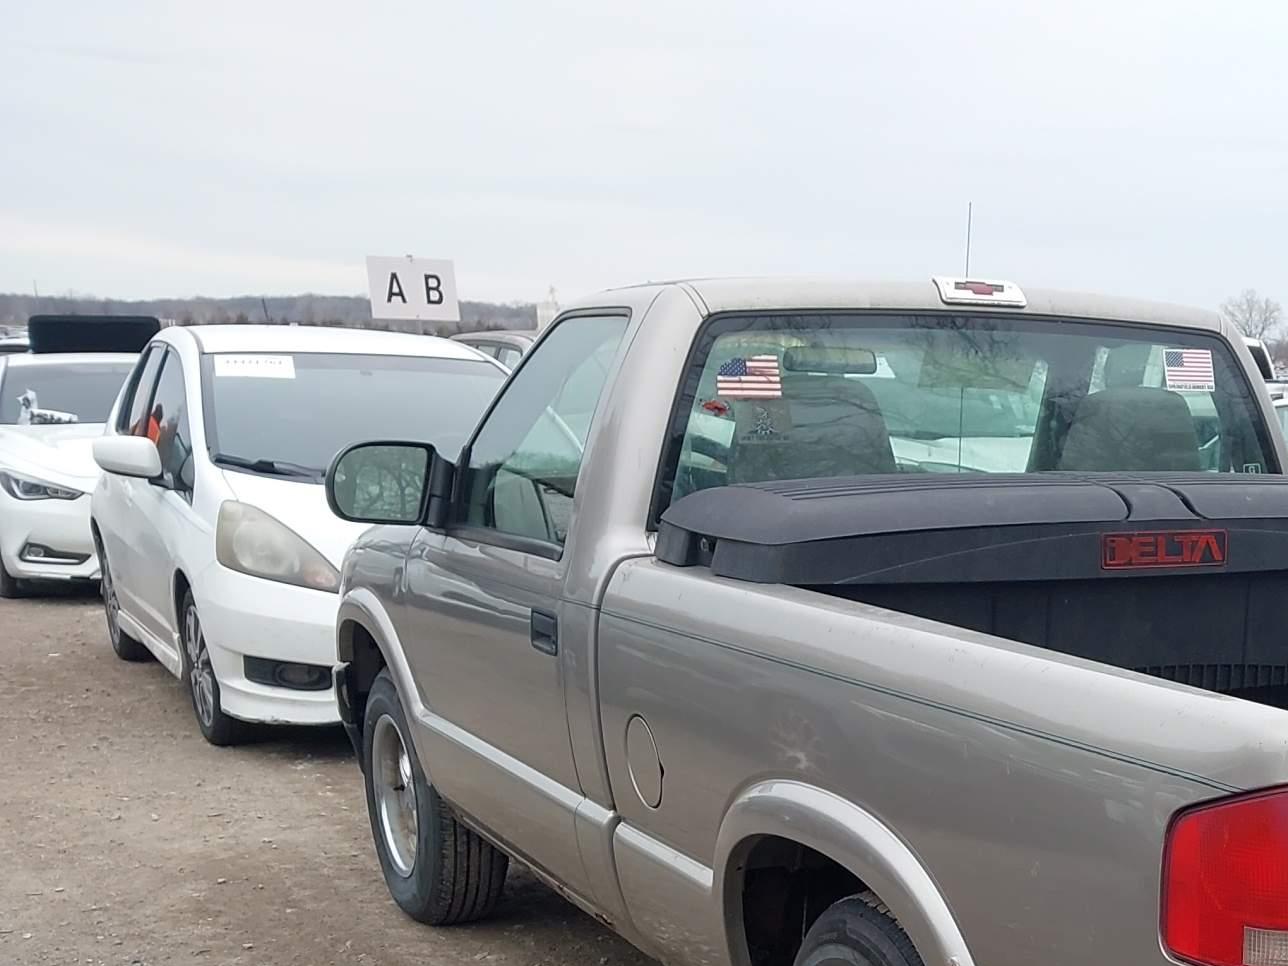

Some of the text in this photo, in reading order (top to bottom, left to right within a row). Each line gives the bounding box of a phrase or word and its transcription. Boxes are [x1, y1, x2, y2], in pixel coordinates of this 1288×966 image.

[387, 272, 444, 305] A B
[1106, 533, 1224, 565] DELTA
